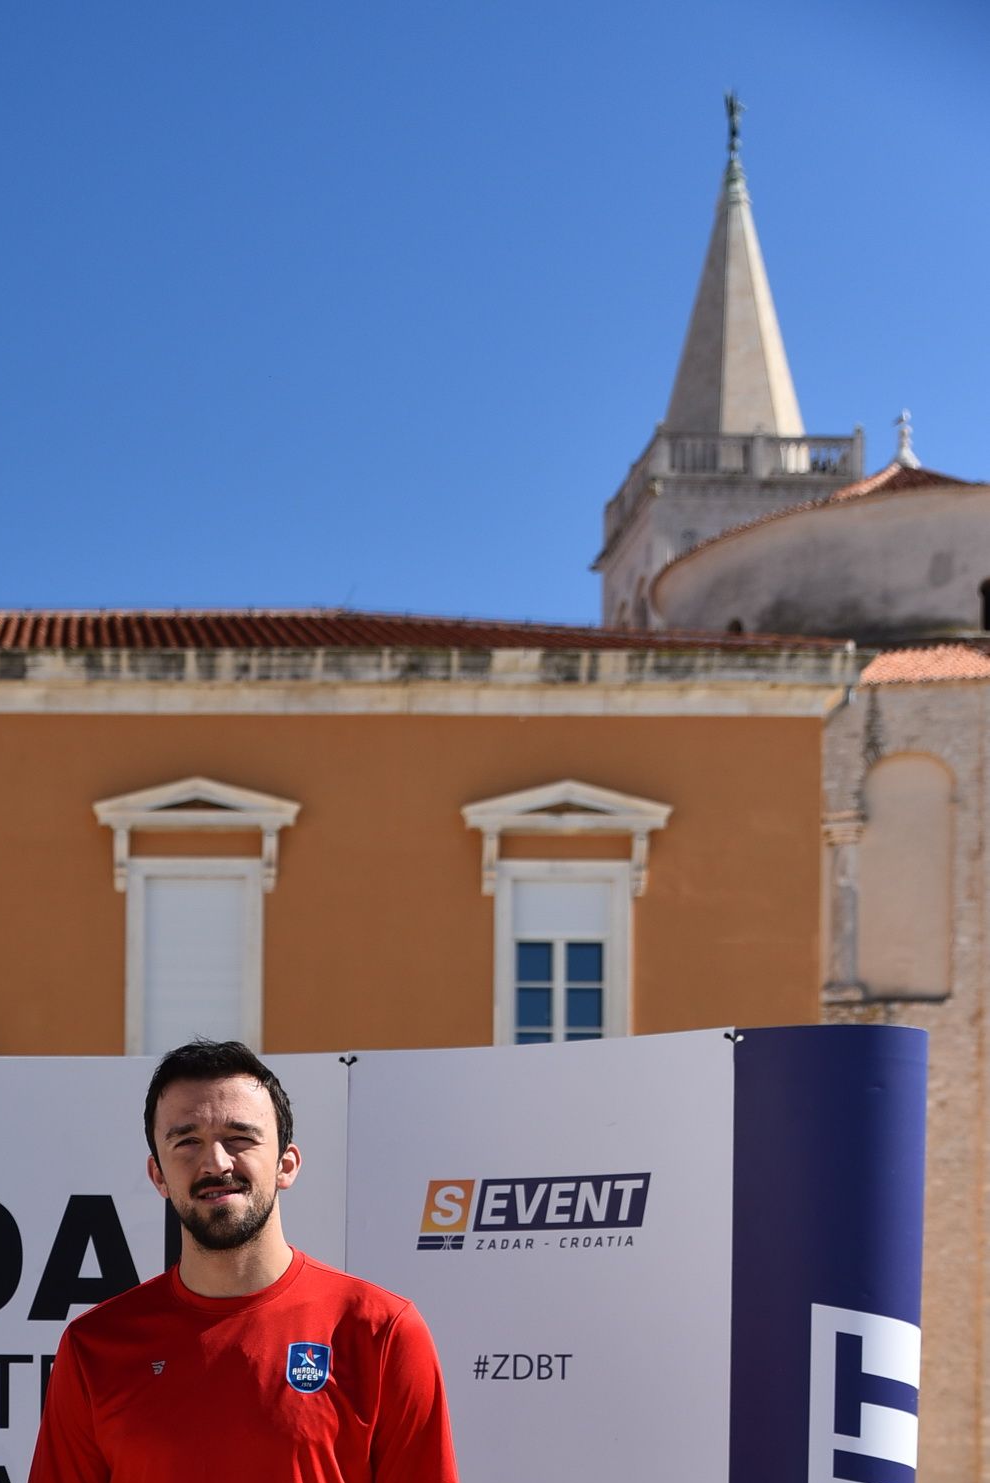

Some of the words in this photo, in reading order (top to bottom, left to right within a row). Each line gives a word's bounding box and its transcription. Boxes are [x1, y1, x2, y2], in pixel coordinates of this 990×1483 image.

[480, 1179, 644, 1225] EVENT
[476, 1238, 534, 1250] ZADAR
[559, 1235, 634, 1249] CROATIA
[473, 1354, 573, 1380] #ZDBT
